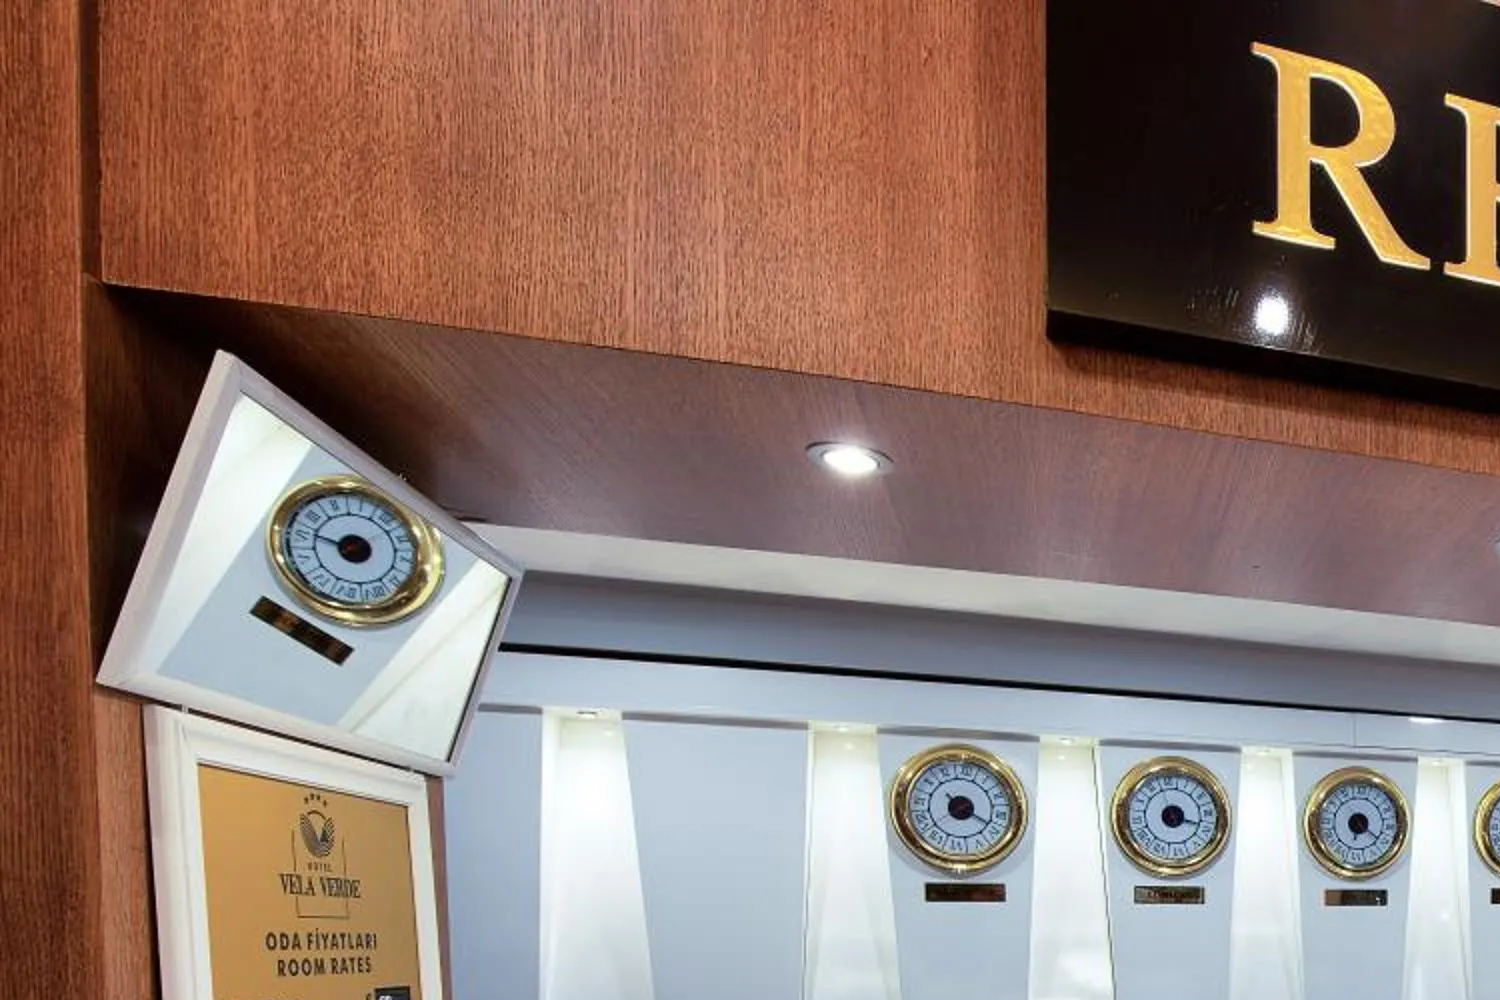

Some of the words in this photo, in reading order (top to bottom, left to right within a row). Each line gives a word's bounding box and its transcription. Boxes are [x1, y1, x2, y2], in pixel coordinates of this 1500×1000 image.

[279, 873, 316, 896] VELA
[320, 876, 360, 898] VERDE
[265, 932, 301, 950] ODA
[307, 928, 377, 949] FİYATLARI
[277, 959, 326, 977] ROOM
[331, 956, 371, 974] RATES
